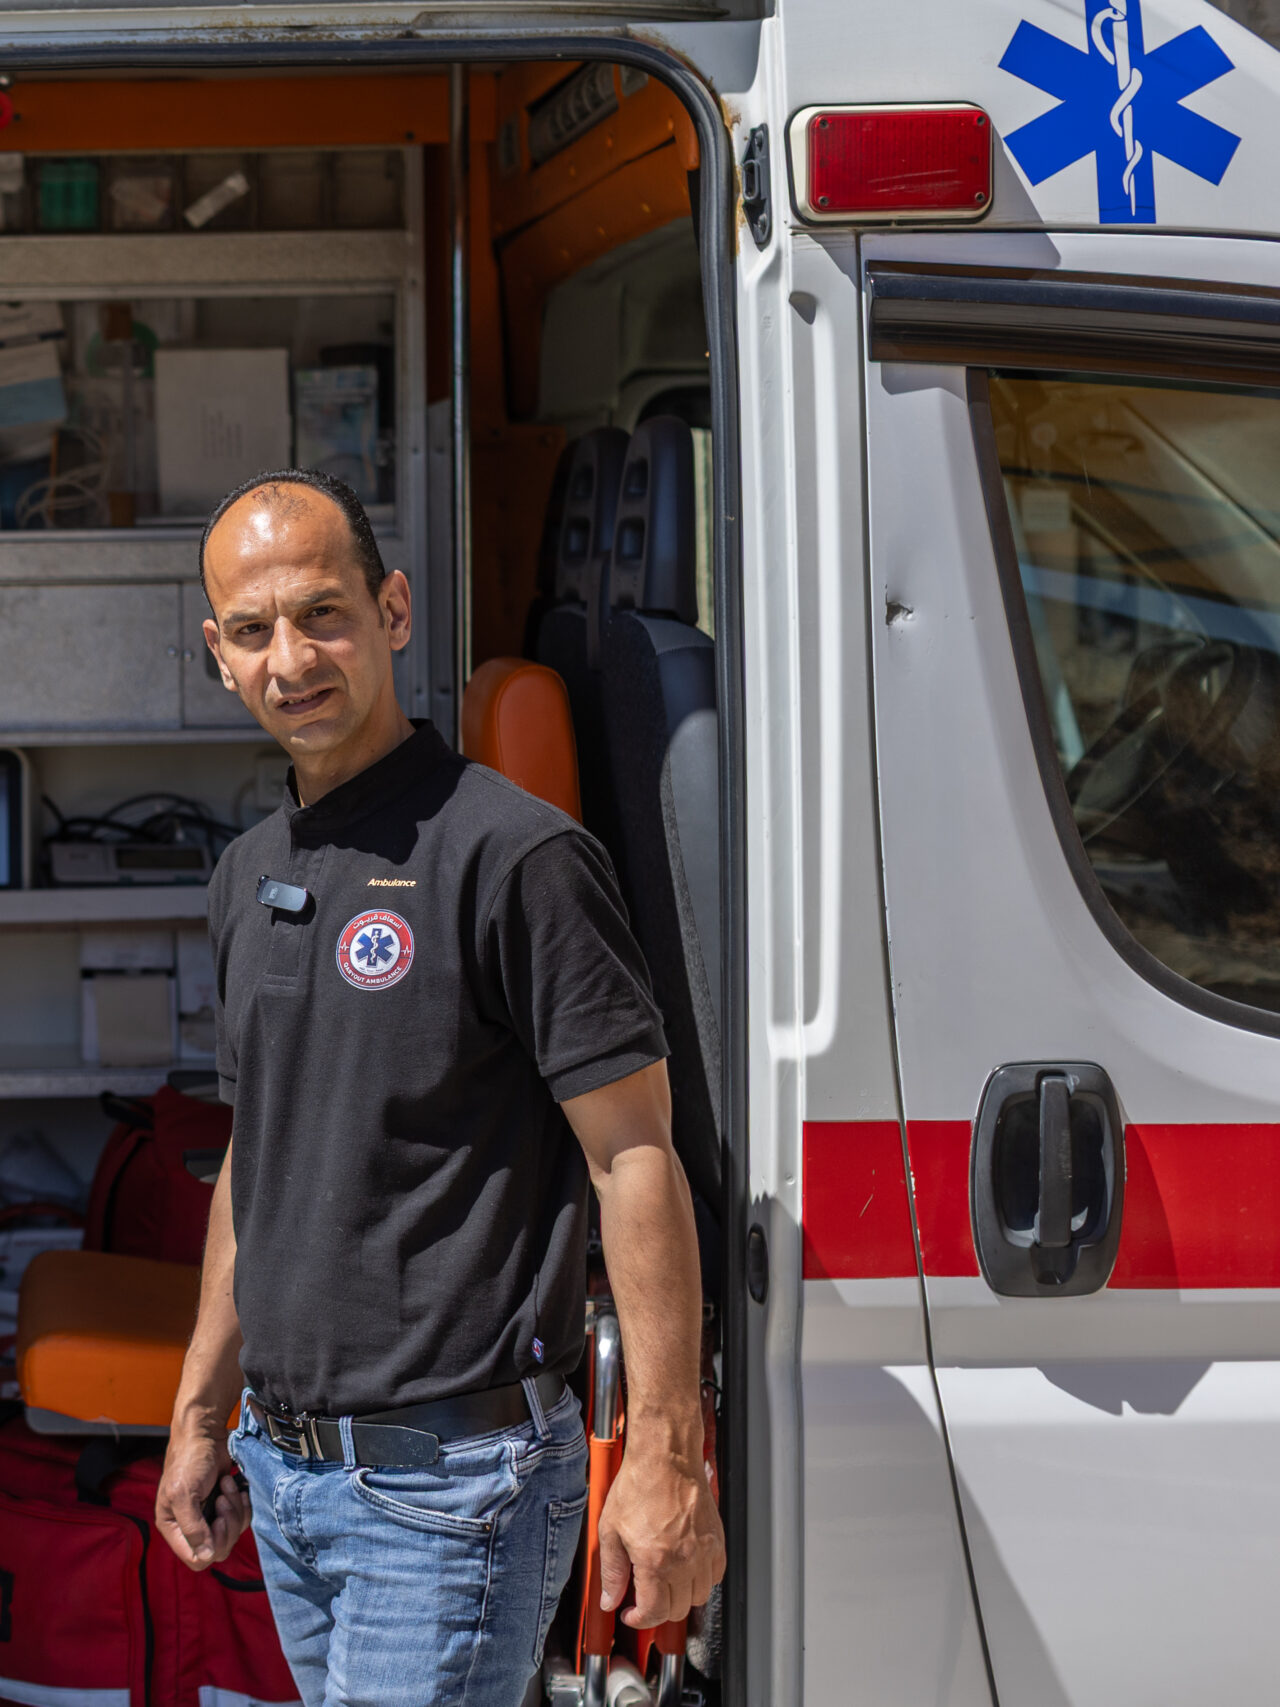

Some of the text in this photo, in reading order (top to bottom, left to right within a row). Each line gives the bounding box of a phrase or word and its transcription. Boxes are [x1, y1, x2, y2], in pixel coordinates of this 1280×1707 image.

[367, 877, 417, 887] Ambulance
[343, 961, 365, 984] QARYOUT
[365, 965, 403, 985] AMBULANCE
